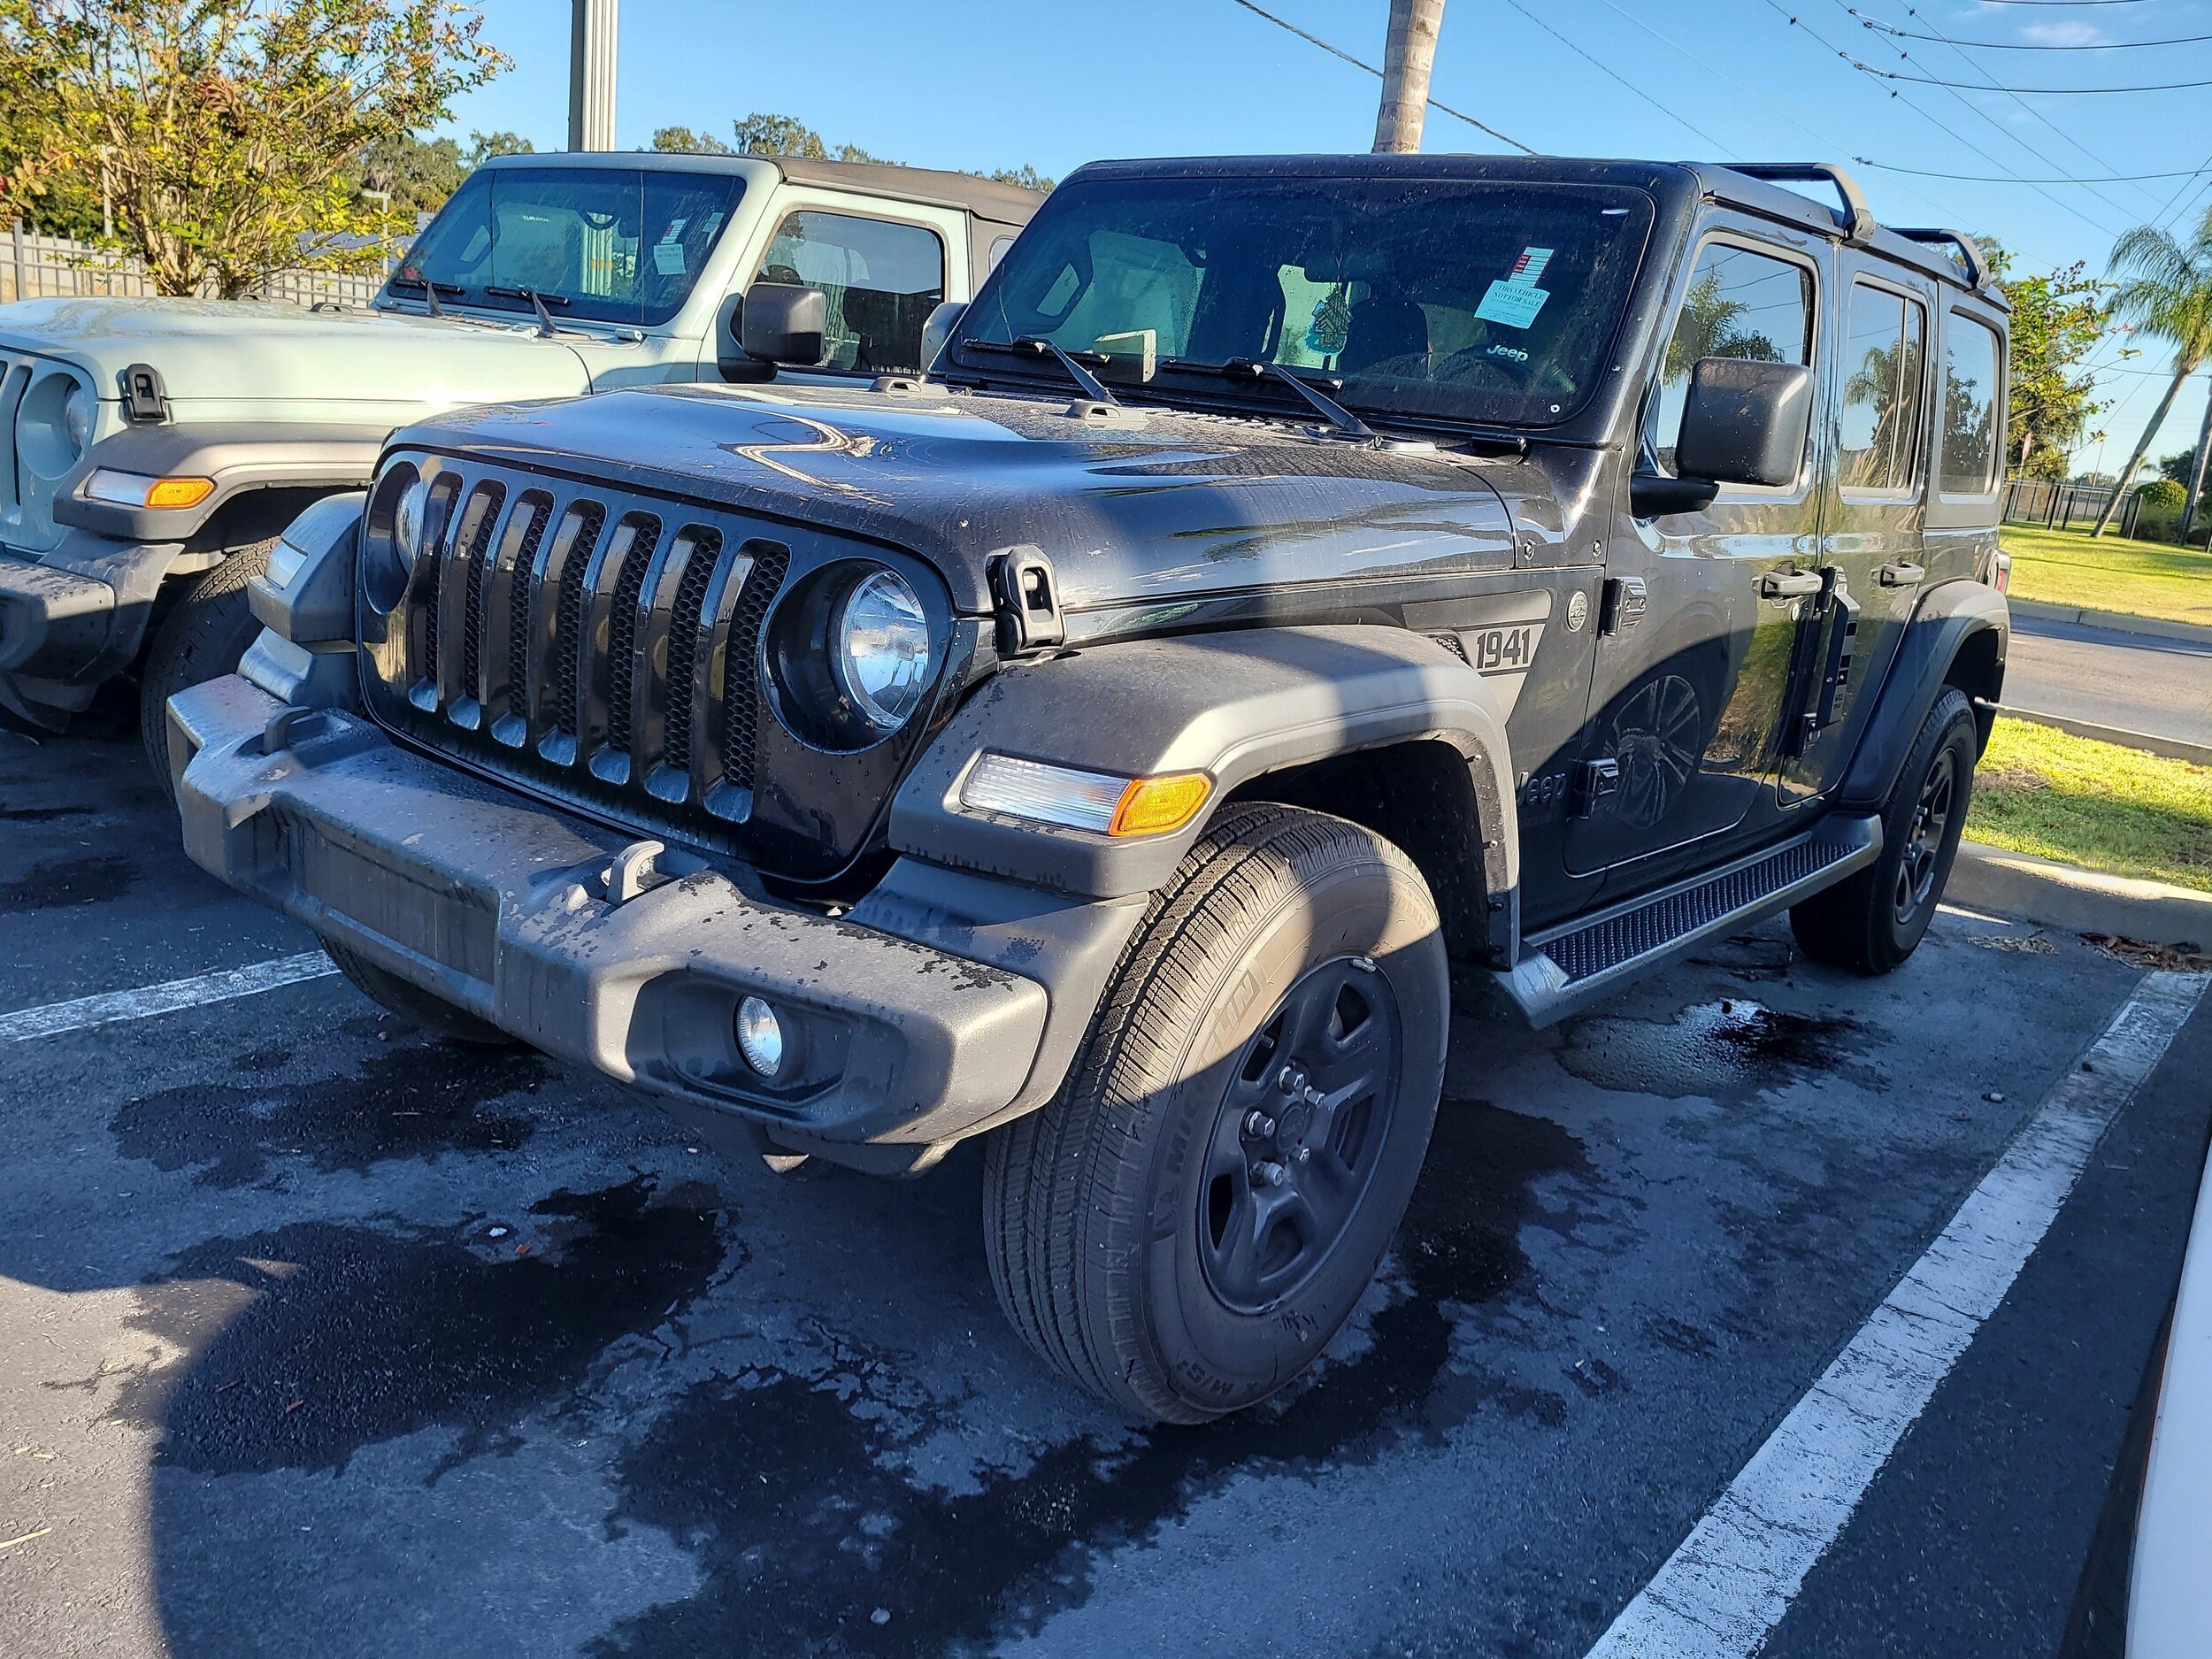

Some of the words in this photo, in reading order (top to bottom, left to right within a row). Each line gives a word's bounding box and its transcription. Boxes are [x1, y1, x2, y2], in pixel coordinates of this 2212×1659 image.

[1494, 291, 1508, 300] NOT
[1507, 294, 1522, 303] FOR
[1522, 299, 1541, 308] SALE
[1498, 284, 1512, 294] THIS
[1512, 288, 1545, 301] VEHICLE
[1486, 344, 1529, 362] Jeep
[1476, 627, 1531, 670] 1941
[1517, 771, 1567, 810] Jeep
